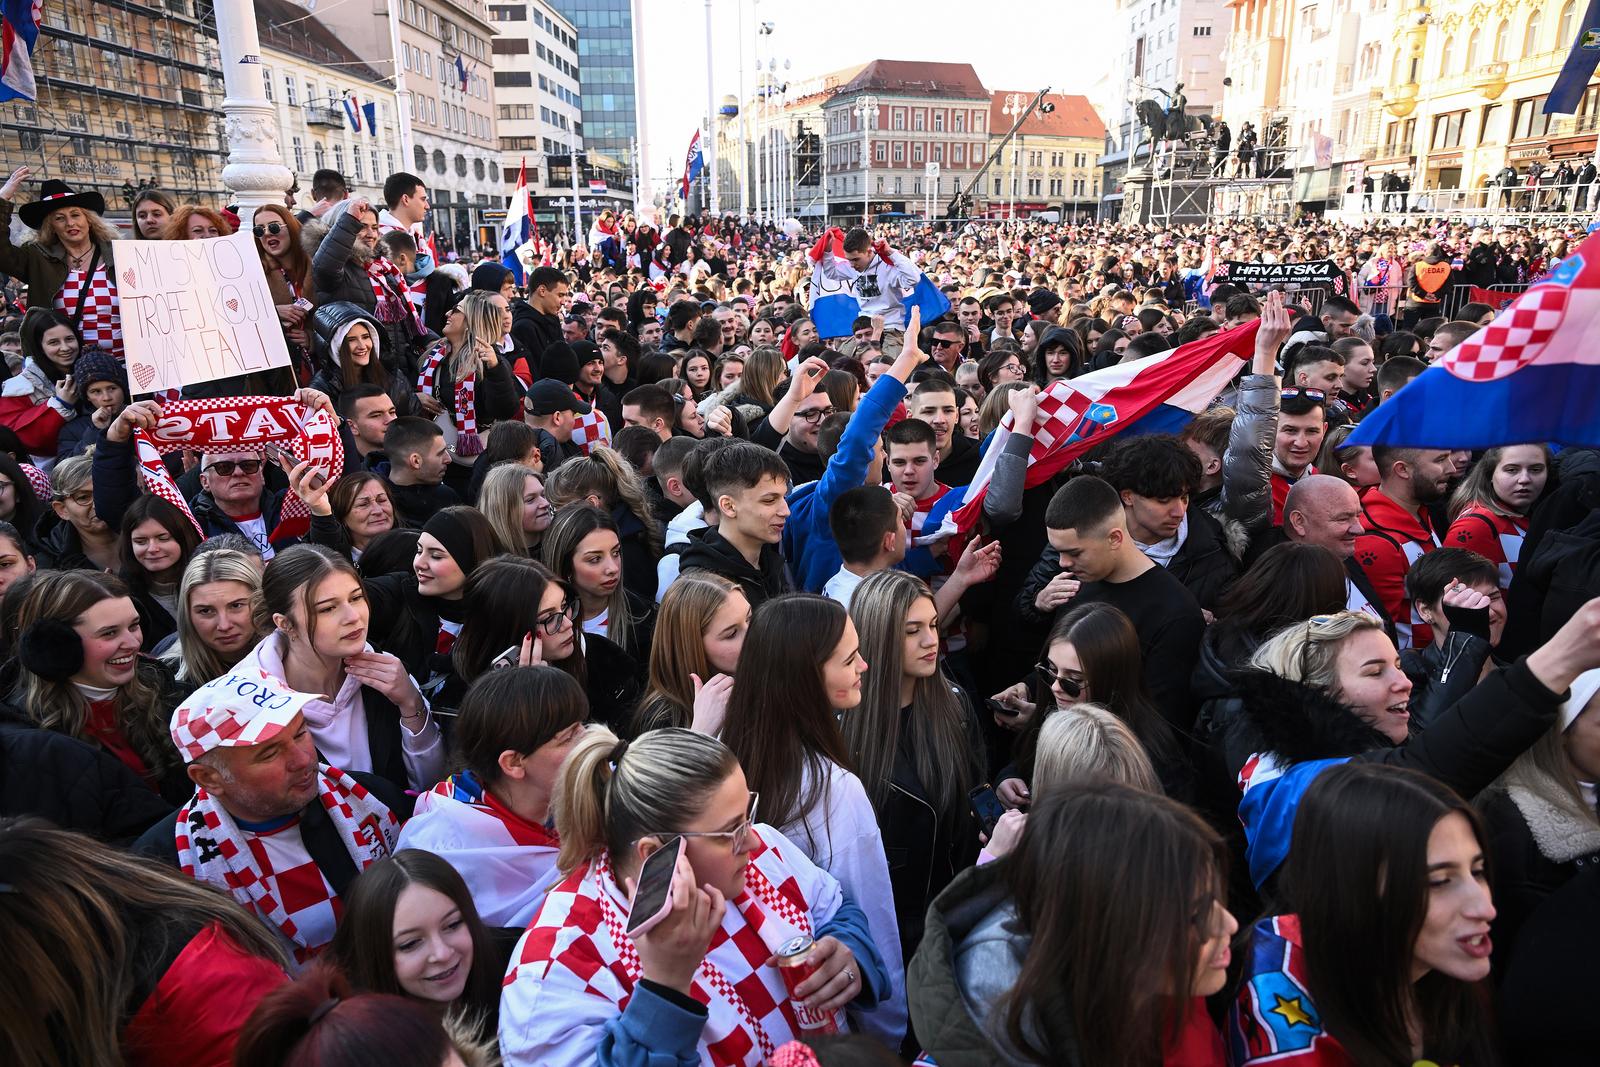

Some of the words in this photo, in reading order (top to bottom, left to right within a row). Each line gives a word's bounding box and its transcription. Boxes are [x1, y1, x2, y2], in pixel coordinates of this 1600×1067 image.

[135, 245, 162, 288] MI
[170, 239, 244, 286] SMO
[1236, 264, 1329, 276] HRVATSKA
[122, 289, 206, 338] TROFEJ
[207, 280, 269, 326] KOJI
[148, 334, 202, 388] VAM
[200, 323, 270, 378] FALI
